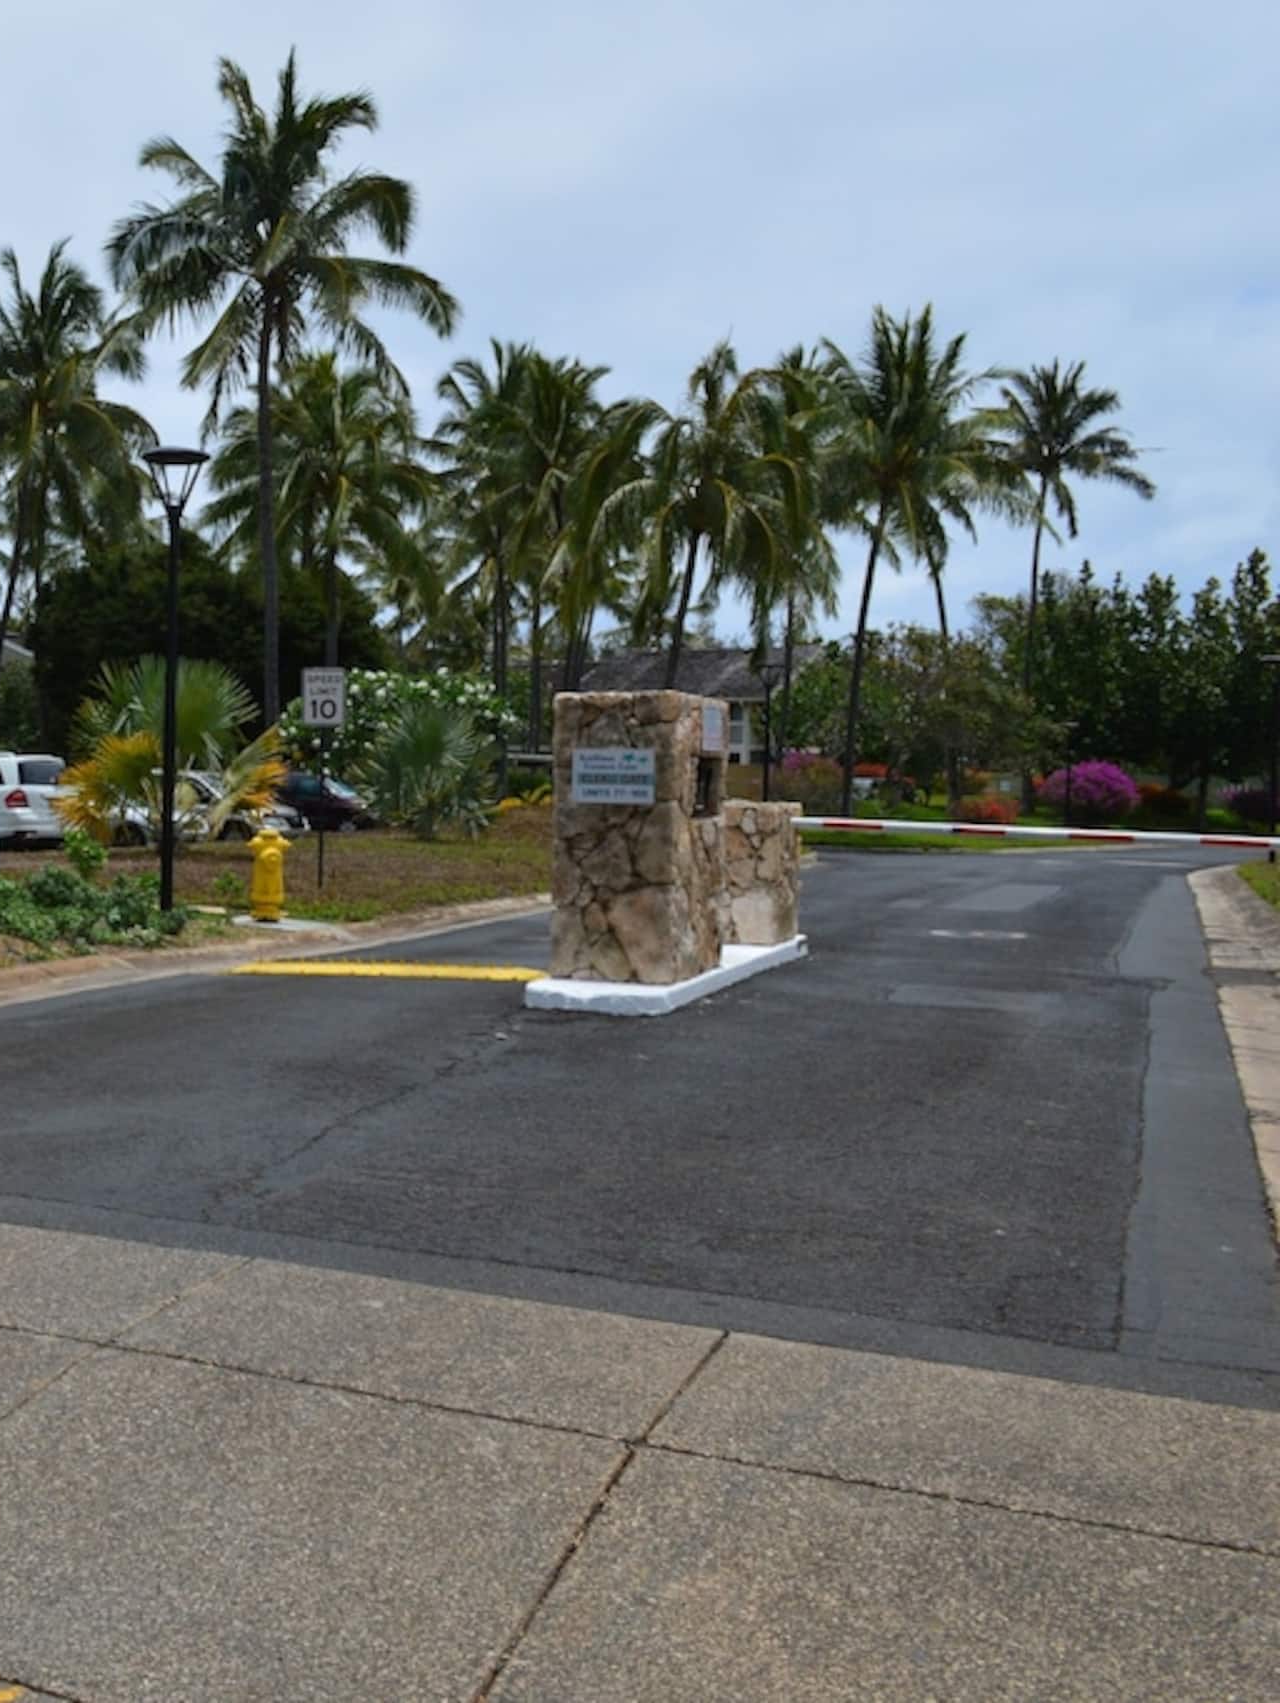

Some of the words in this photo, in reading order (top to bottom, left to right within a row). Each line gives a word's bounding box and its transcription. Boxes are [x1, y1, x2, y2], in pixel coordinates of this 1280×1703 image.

[307, 674, 341, 684] SPEED
[310, 687, 337, 697] LIMIT
[311, 699, 337, 719] 10
